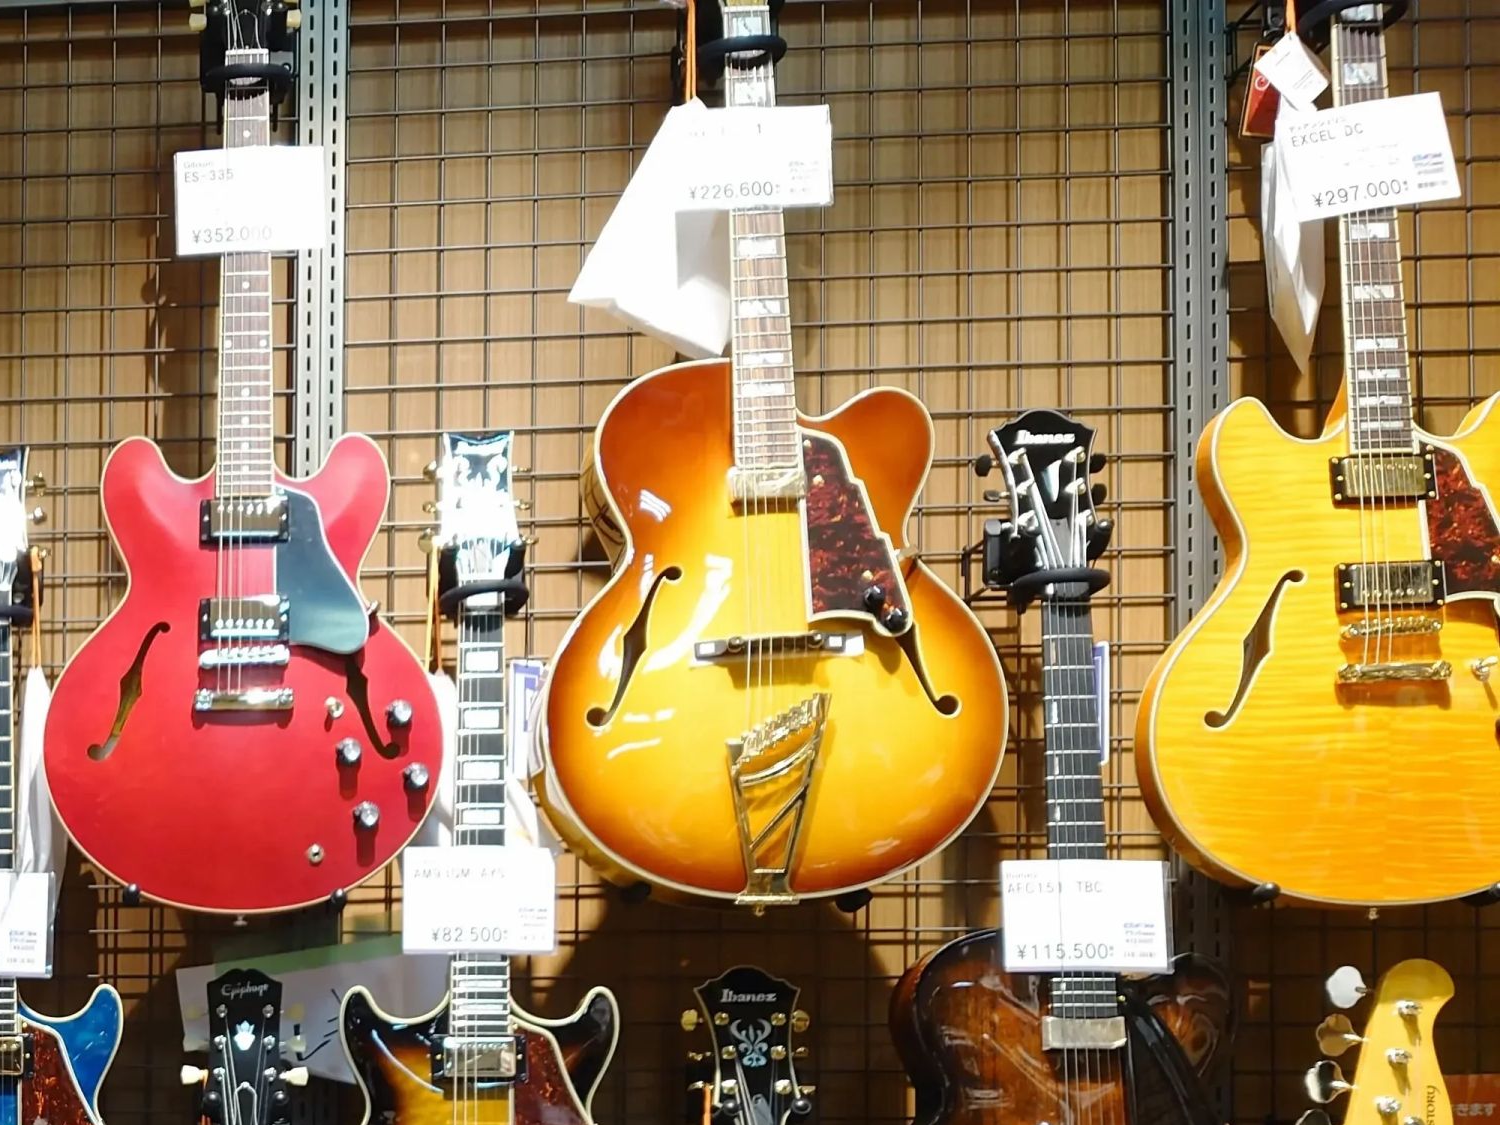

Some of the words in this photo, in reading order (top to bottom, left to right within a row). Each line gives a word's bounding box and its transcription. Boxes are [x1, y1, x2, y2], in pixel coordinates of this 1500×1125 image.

[1290, 129, 1338, 149] EXCEL
[1342, 121, 1365, 138] DC
[183, 168, 234, 184] ES-335
[1311, 178, 1402, 208] ¥297,000
[1015, 429, 1076, 445] Ibanez
[1075, 880, 1103, 894] TBC
[431, 926, 503, 943] ¥82500
[221, 979, 270, 1000] Epiphone
[719, 988, 778, 1004] Ibanez
